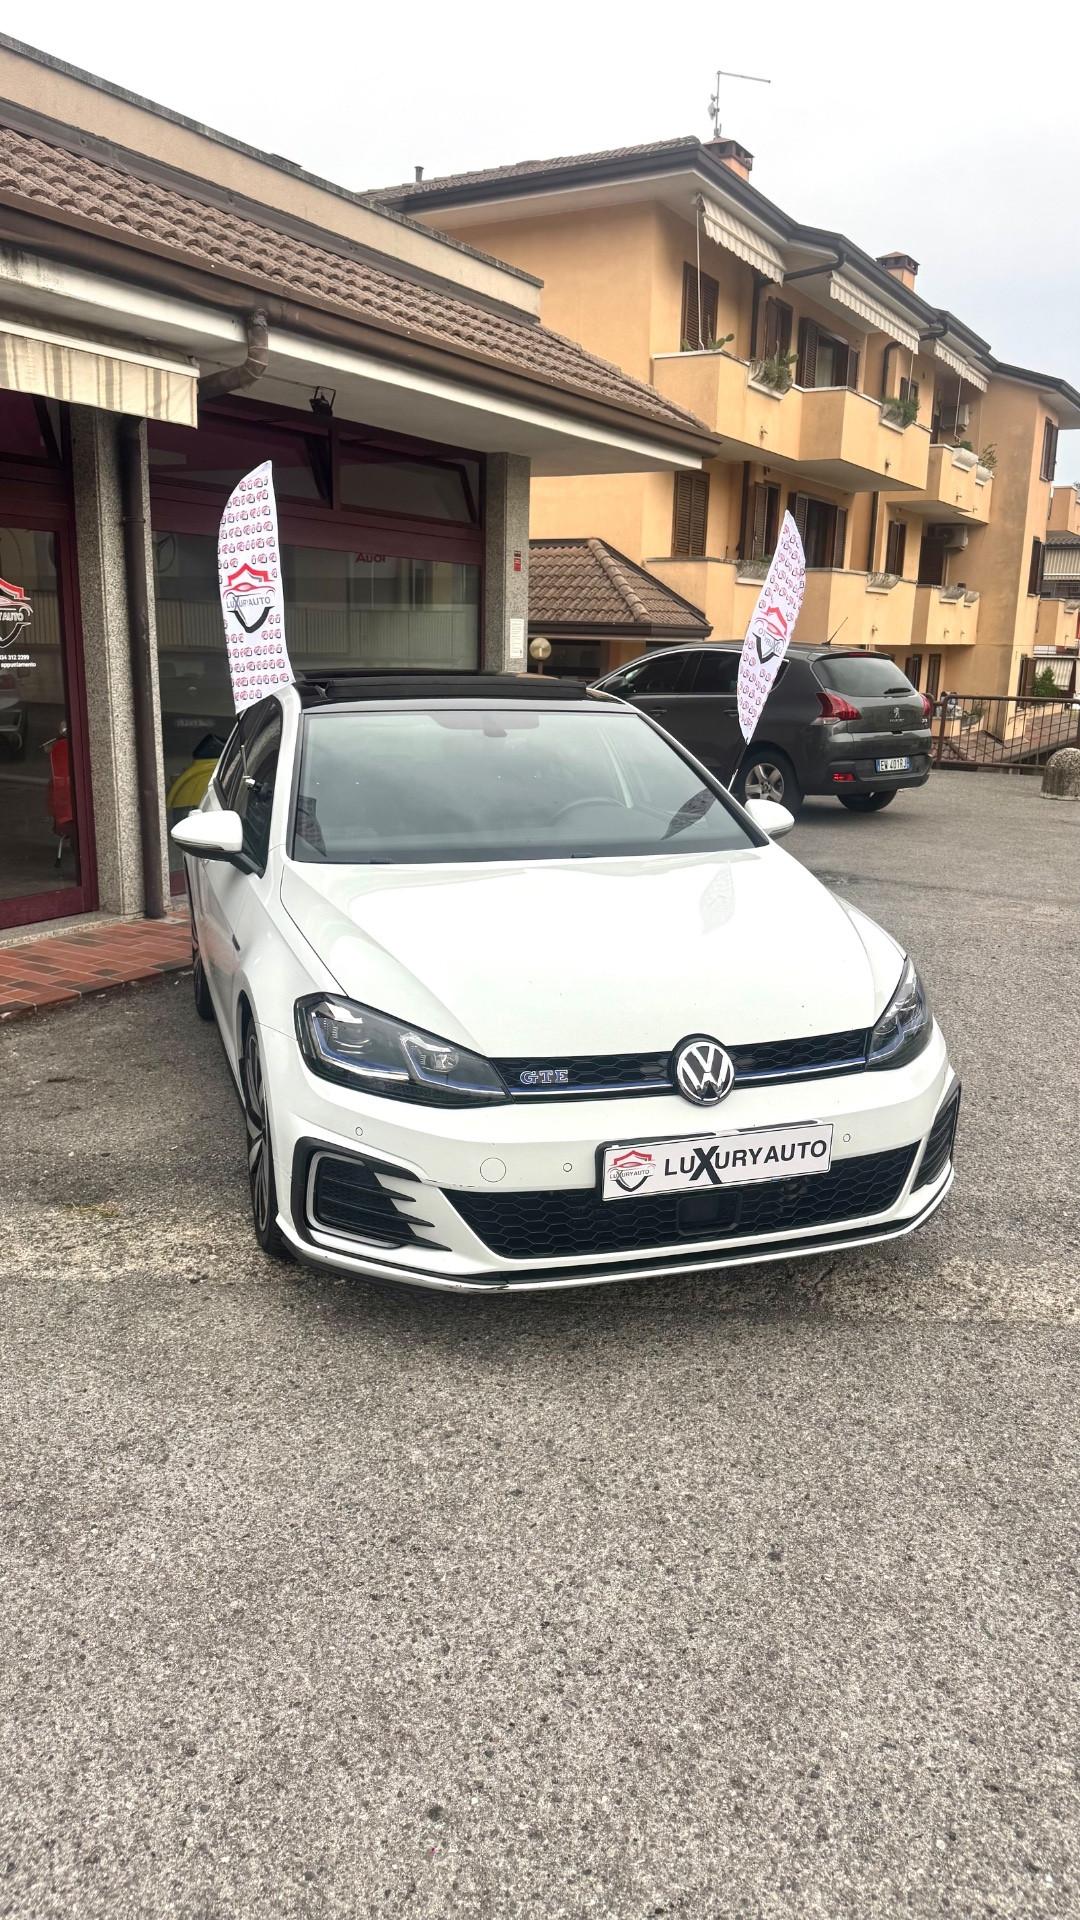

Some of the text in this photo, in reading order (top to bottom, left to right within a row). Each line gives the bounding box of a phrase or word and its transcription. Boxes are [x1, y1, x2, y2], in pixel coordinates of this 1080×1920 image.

[520, 1069, 568, 1085] GTE
[664, 1140, 827, 1184] LUXURYAUTO
[609, 1169, 650, 1181] LUXURYAUTO
